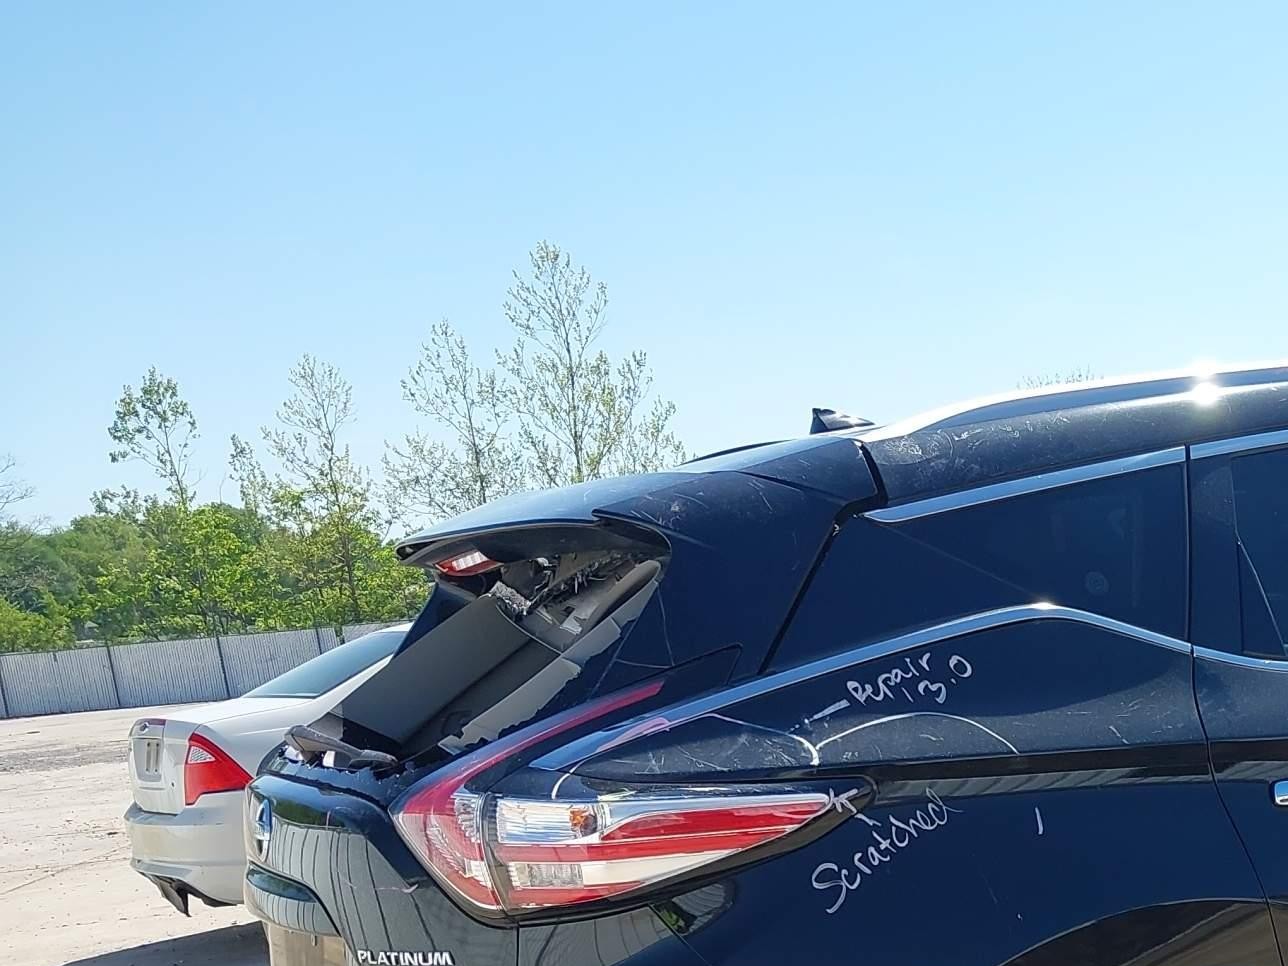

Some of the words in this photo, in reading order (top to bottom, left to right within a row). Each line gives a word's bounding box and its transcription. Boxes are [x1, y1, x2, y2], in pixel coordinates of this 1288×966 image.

[846, 652, 932, 705] Repair
[811, 787, 963, 914] Scratched
[357, 950, 454, 966] PLATINUM
